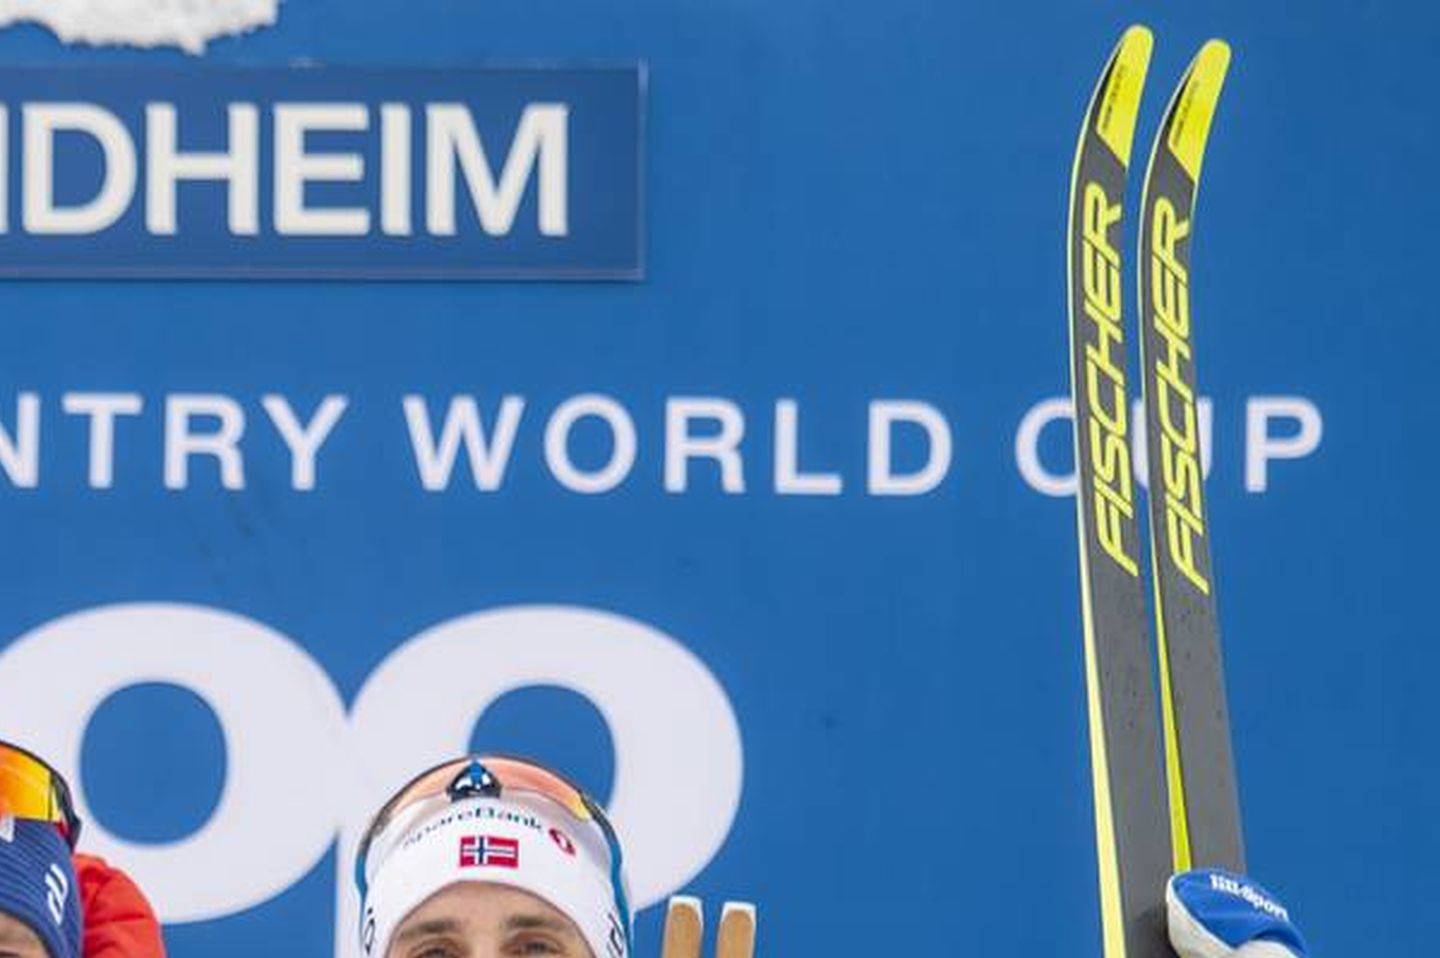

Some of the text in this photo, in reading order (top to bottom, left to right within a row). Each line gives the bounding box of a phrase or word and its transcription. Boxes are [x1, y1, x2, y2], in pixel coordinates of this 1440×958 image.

[403, 394, 953, 496] WORLD
[1083, 182, 1140, 579] FISCHER
[1151, 197, 1210, 596] FISCHER
